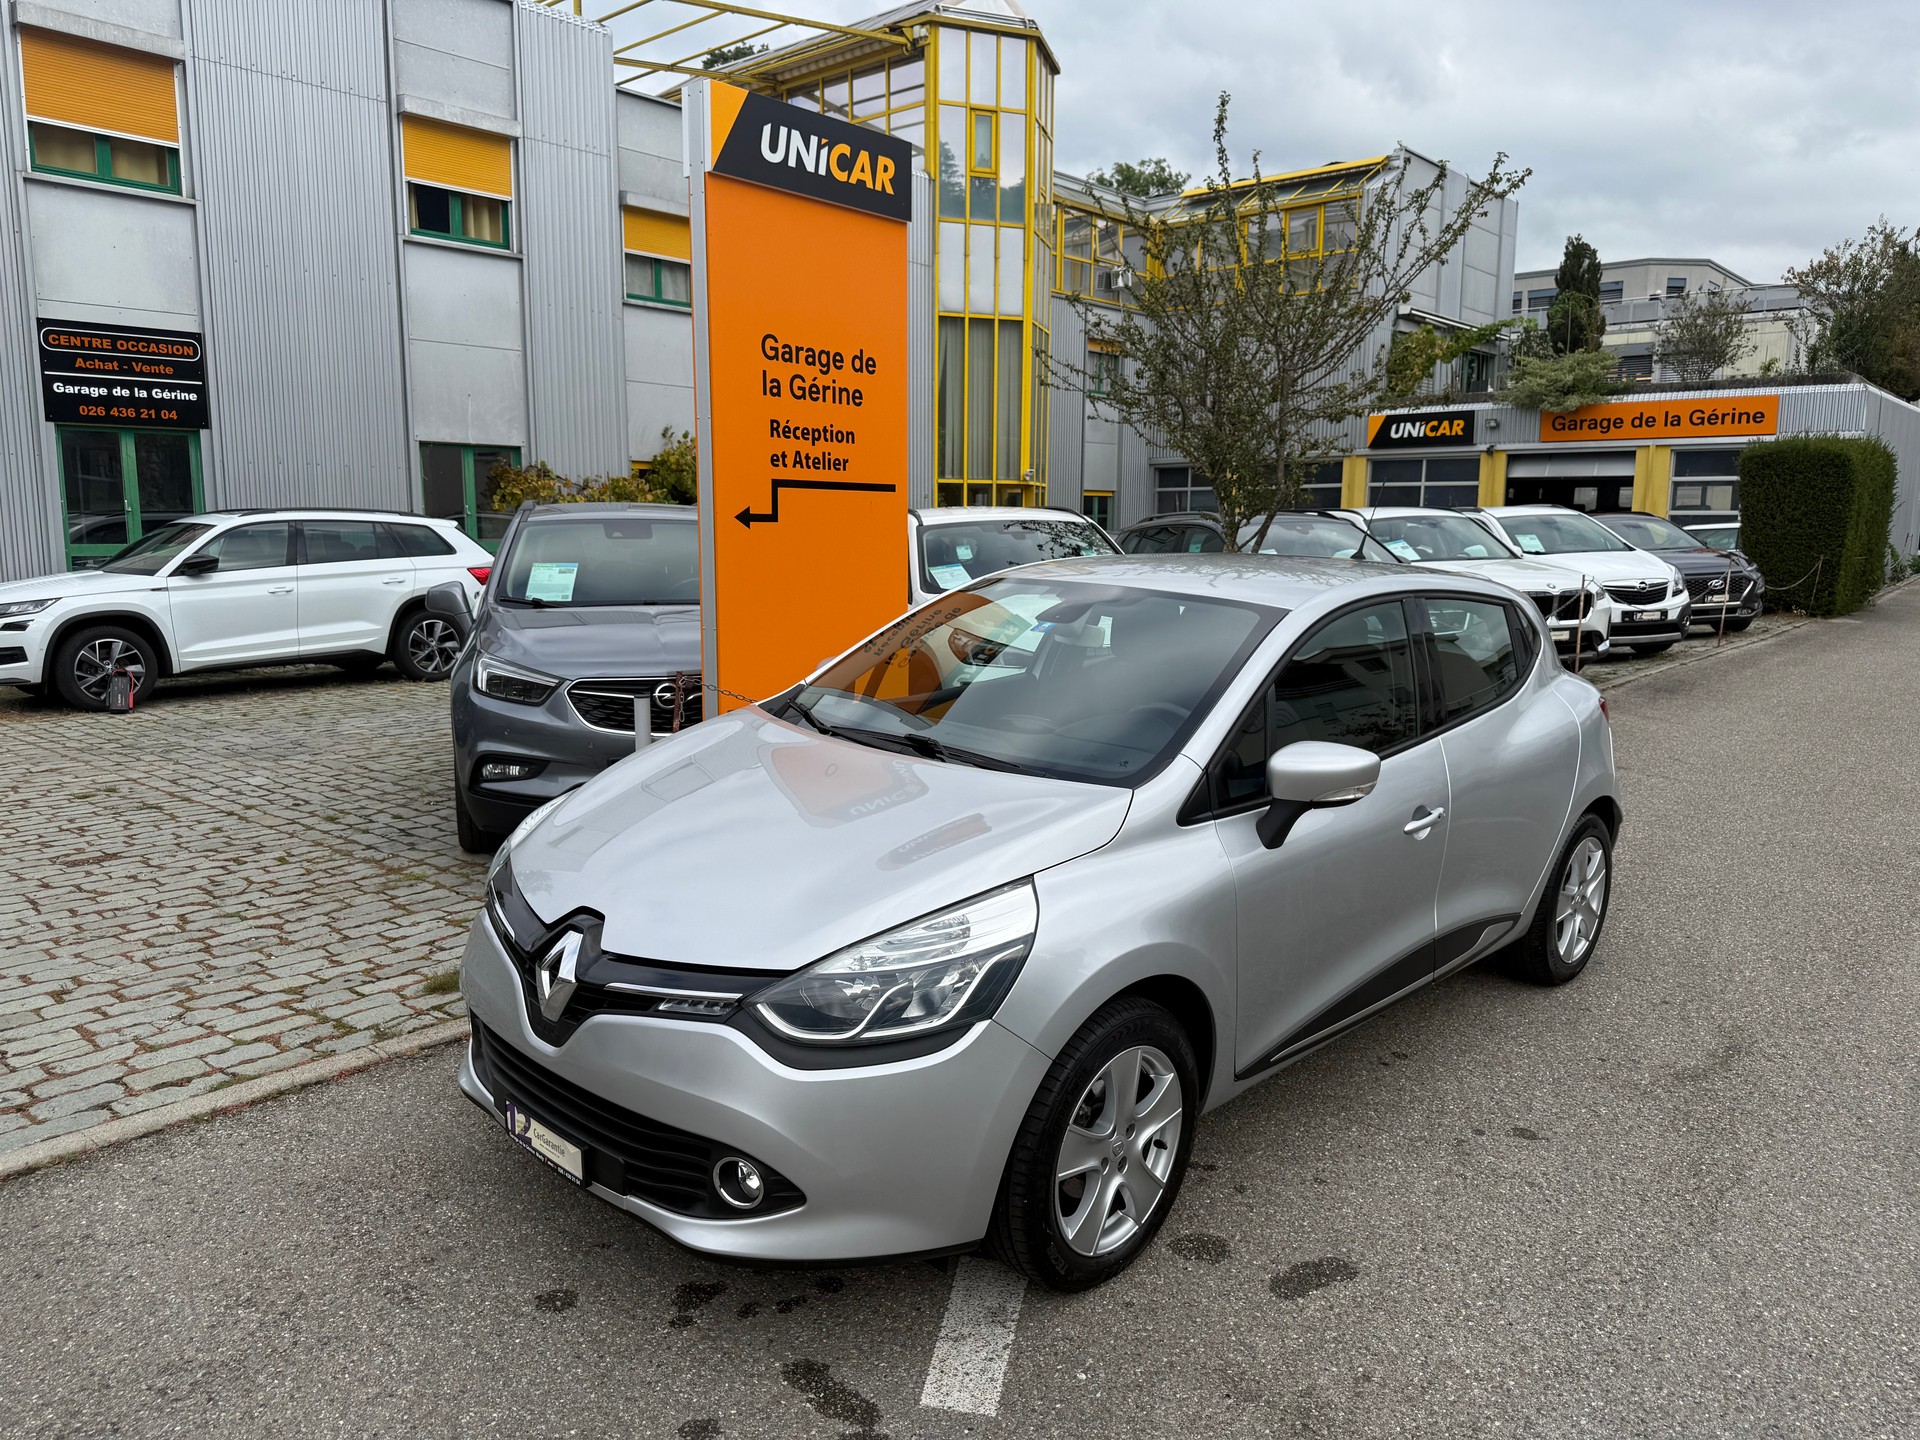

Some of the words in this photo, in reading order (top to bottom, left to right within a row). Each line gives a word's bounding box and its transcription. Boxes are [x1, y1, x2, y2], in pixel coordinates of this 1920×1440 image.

[48, 333, 112, 349] CENTRE
[116, 340, 194, 356] OCCASION
[761, 333, 845, 375] Garage
[851, 348, 877, 375] de
[75, 357, 119, 371] Achat
[132, 361, 174, 375] Vente
[52, 382, 108, 398] Garage
[112, 386, 130, 397] de
[134, 387, 148, 398] la
[151, 388, 198, 401] Gérine
[762, 369, 782, 398] la
[789, 373, 864, 407] Gérine
[79, 405, 106, 416] 026
[110, 407, 136, 418] 436
[140, 408, 156, 419] 21
[160, 409, 178, 420] 04
[1551, 415, 1624, 434] Garage
[1630, 412, 1657, 429] de
[1663, 411, 1681, 427] la
[1688, 408, 1766, 427] Gérine
[769, 418, 856, 446] Réception
[770, 450, 788, 468] et
[792, 450, 849, 472] Atelier
[533, 1128, 566, 1158] CarGarantie
